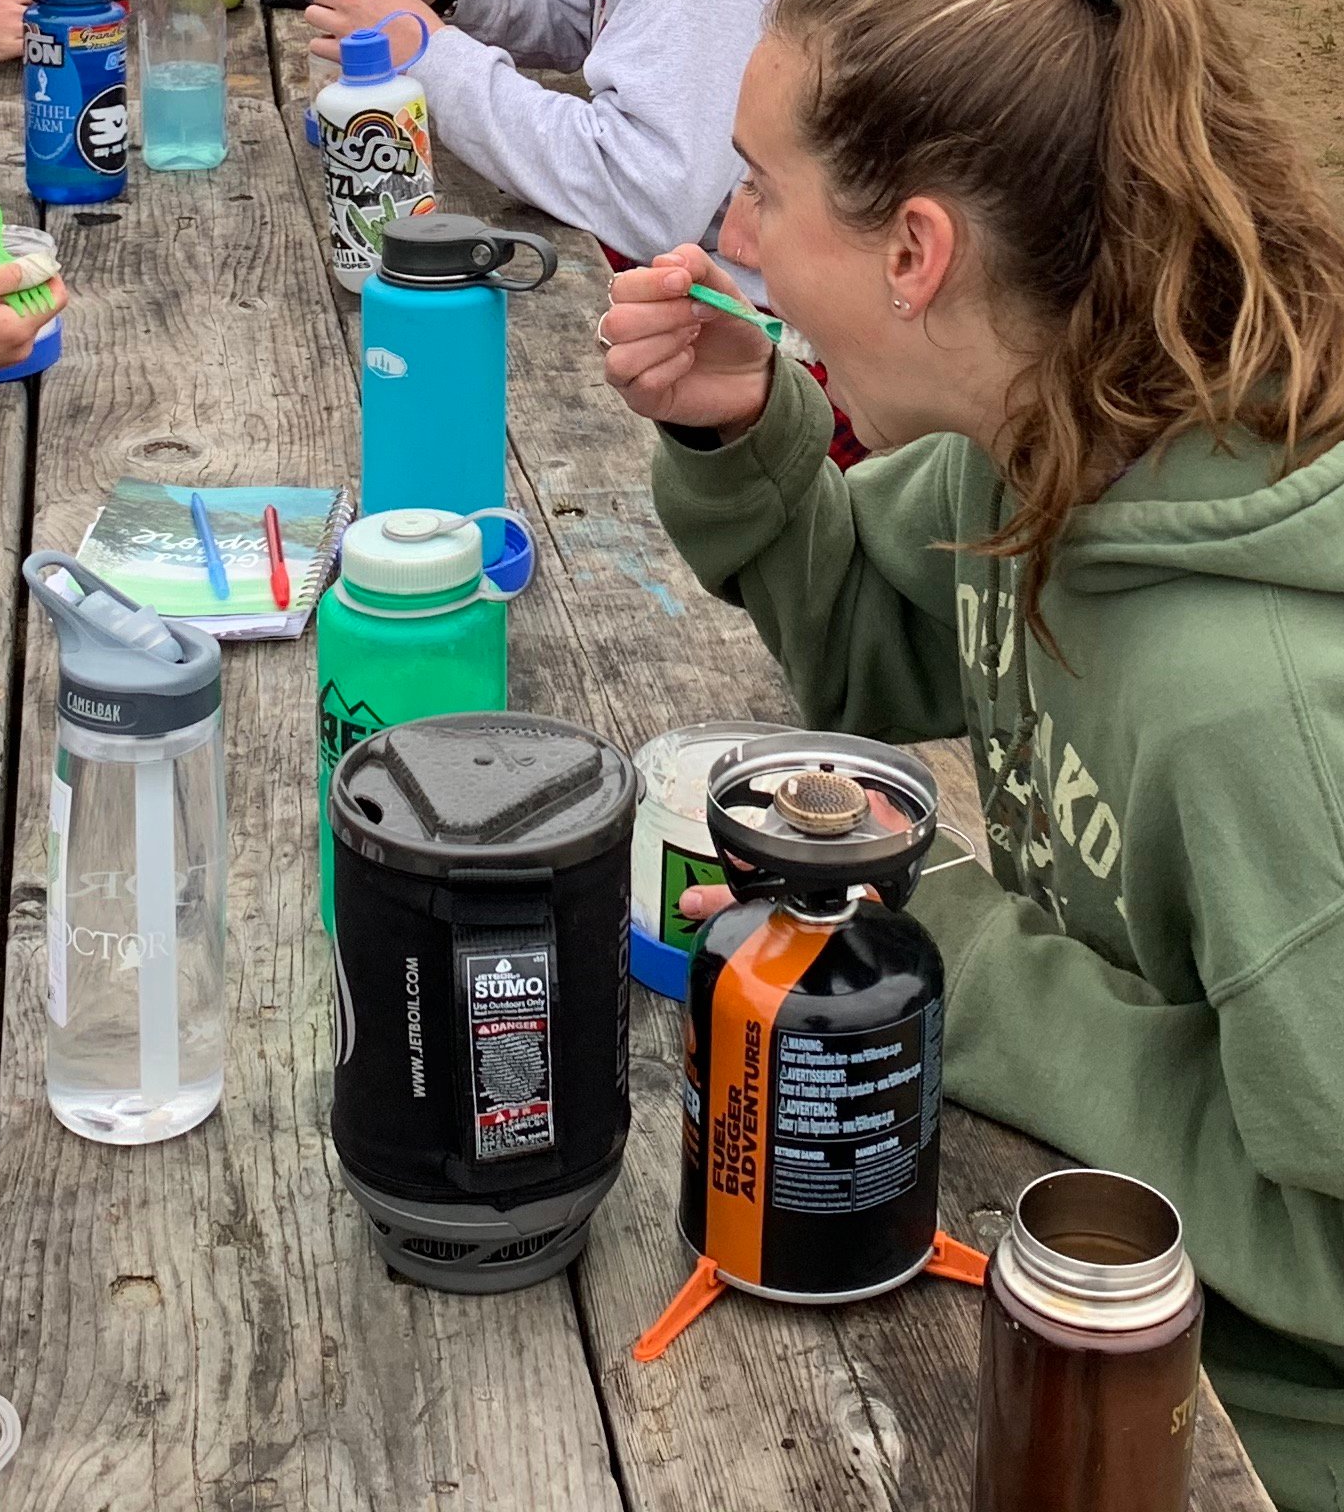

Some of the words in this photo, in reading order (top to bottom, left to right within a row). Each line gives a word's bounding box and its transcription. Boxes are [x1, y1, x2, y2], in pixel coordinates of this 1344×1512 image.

[28, 103, 76, 120] ETHEL
[473, 1001, 488, 1012] Use
[489, 999, 525, 1010] Outdoors
[526, 998, 545, 1009] Only
[475, 977, 544, 999] SUMO
[406, 957, 426, 1098] WWW.JETBOIL.COM
[490, 1021, 538, 1034] DANGER
[740, 1019, 762, 1204] ADVENTURES
[712, 1112, 727, 1193] FUEL
[725, 1084, 743, 1197] BIGGER
